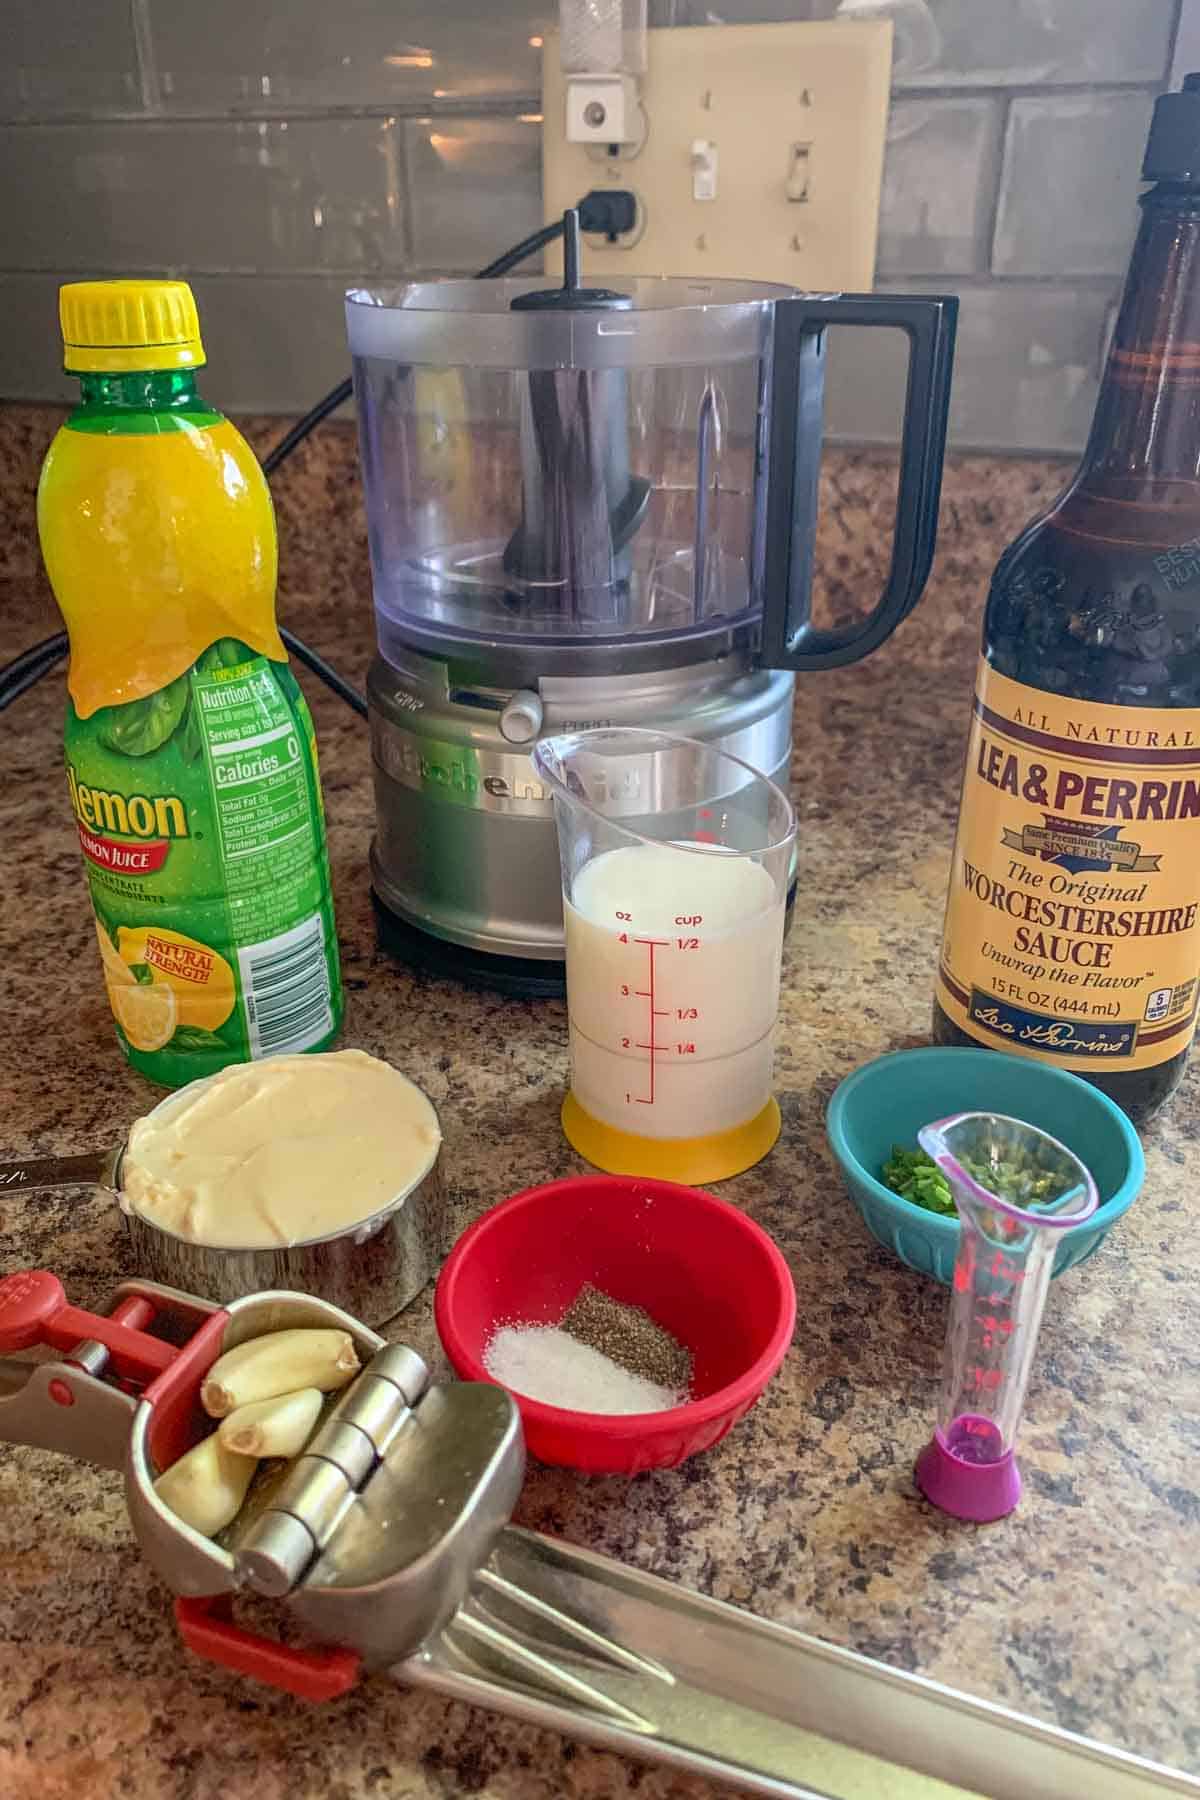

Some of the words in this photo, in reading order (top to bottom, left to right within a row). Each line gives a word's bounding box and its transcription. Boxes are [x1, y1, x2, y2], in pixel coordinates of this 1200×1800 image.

[201, 685, 251, 709] Nutrition
[208, 729, 241, 743] Serving
[1013, 706, 1051, 731] ALL
[1066, 720, 1195, 746] NATURAL
[287, 736, 299, 760] 0
[215, 755, 280, 784] Calories
[111, 847, 151, 868] JUICE
[1043, 841, 1079, 856] SINCE
[1007, 860, 1043, 888] The
[1050, 874, 1148, 904] Original
[963, 861, 1199, 938] WORCESTERSHIRE
[615, 911, 633, 922] oz
[674, 915, 703, 927] cup
[146, 938, 214, 969] NATURAL
[619, 934, 628, 944] 4
[676, 938, 700, 950] 1/2
[1014, 926, 1113, 968] SAUCE
[144, 948, 211, 982] STRENGTH
[980, 942, 1046, 980] Unwrap
[1050, 967, 1079, 985] the
[621, 985, 629, 996] 3
[676, 1009, 698, 1020] 1/3
[991, 976, 1006, 993] 15
[1008, 986, 1024, 1001] FL
[1027, 991, 1050, 1008] OZ
[1053, 996, 1089, 1016] (444
[1091, 1001, 1121, 1017] mL)
[1156, 993, 1165, 1006] 5
[622, 1038, 630, 1048] 2
[625, 1094, 631, 1103] 1
